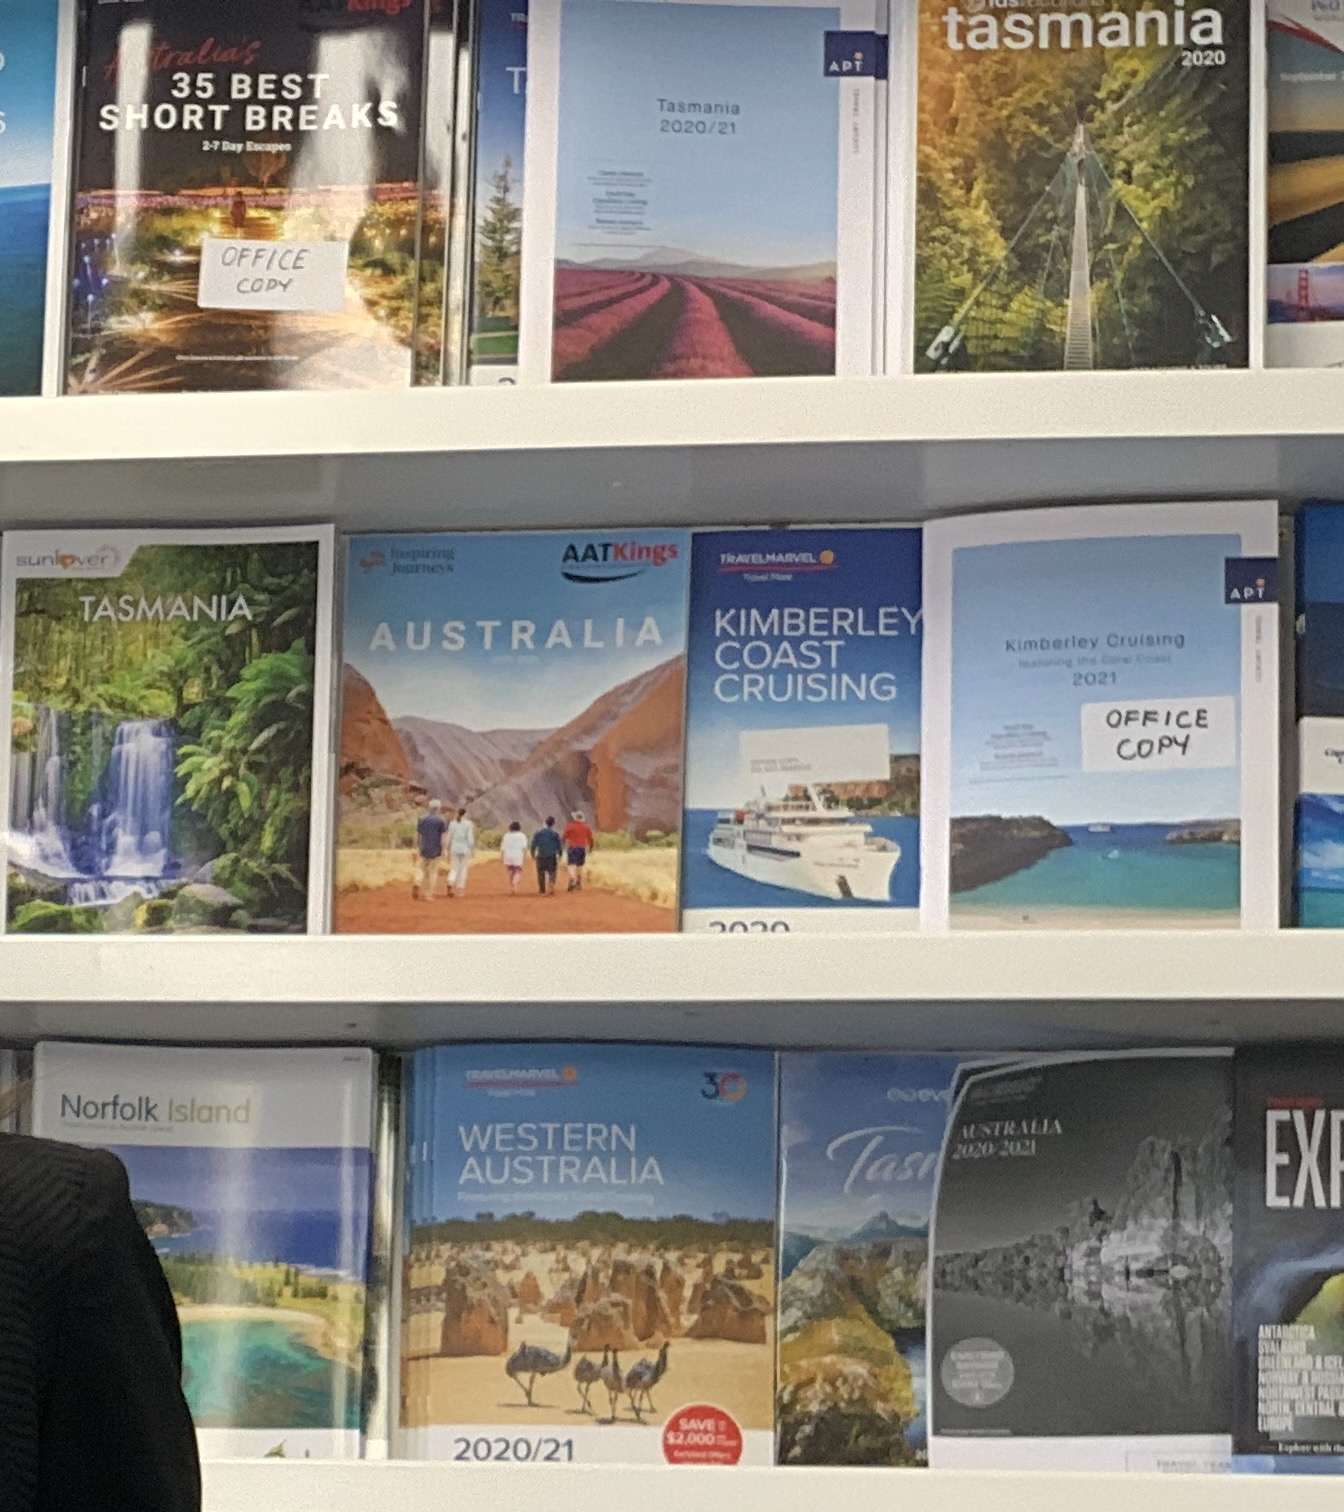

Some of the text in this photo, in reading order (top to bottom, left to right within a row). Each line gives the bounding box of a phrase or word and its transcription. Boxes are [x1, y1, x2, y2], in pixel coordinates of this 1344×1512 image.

[943, 0, 1223, 50] tasmania
[828, 60, 864, 73] APT
[1181, 51, 1226, 66] 2020
[170, 72, 329, 99] 35 BEST
[99, 100, 399, 132] SHORT BREAKS
[657, 98, 740, 116] Tasmania
[660, 120, 737, 135] 2020/21
[223, 141, 243, 154] Day
[221, 245, 307, 271] OFFICE
[236, 278, 293, 294] COPY
[16, 545, 110, 570] sunlover
[562, 541, 679, 567] AATKings
[1230, 588, 1265, 599] APT
[80, 595, 253, 622] TASMANIA
[715, 607, 923, 636] KIMBERLEY
[369, 615, 663, 651] AUSTRALIA
[1005, 632, 1186, 652] Kimberley Cruising
[715, 640, 845, 670] COAST
[715, 673, 897, 702] CRUISING
[1072, 672, 1117, 686] 2021
[1106, 708, 1208, 728] OFFICE
[1116, 734, 1190, 760] COPY
[61, 1094, 250, 1124] Norfolk Island
[458, 1123, 637, 1152] WESTERN
[960, 1118, 1062, 1139] AUSTRALIA
[458, 1155, 665, 1185] AUSTRALIA
[678, 1418, 714, 1431] SAVE
[454, 1436, 574, 1462] 2020/21
